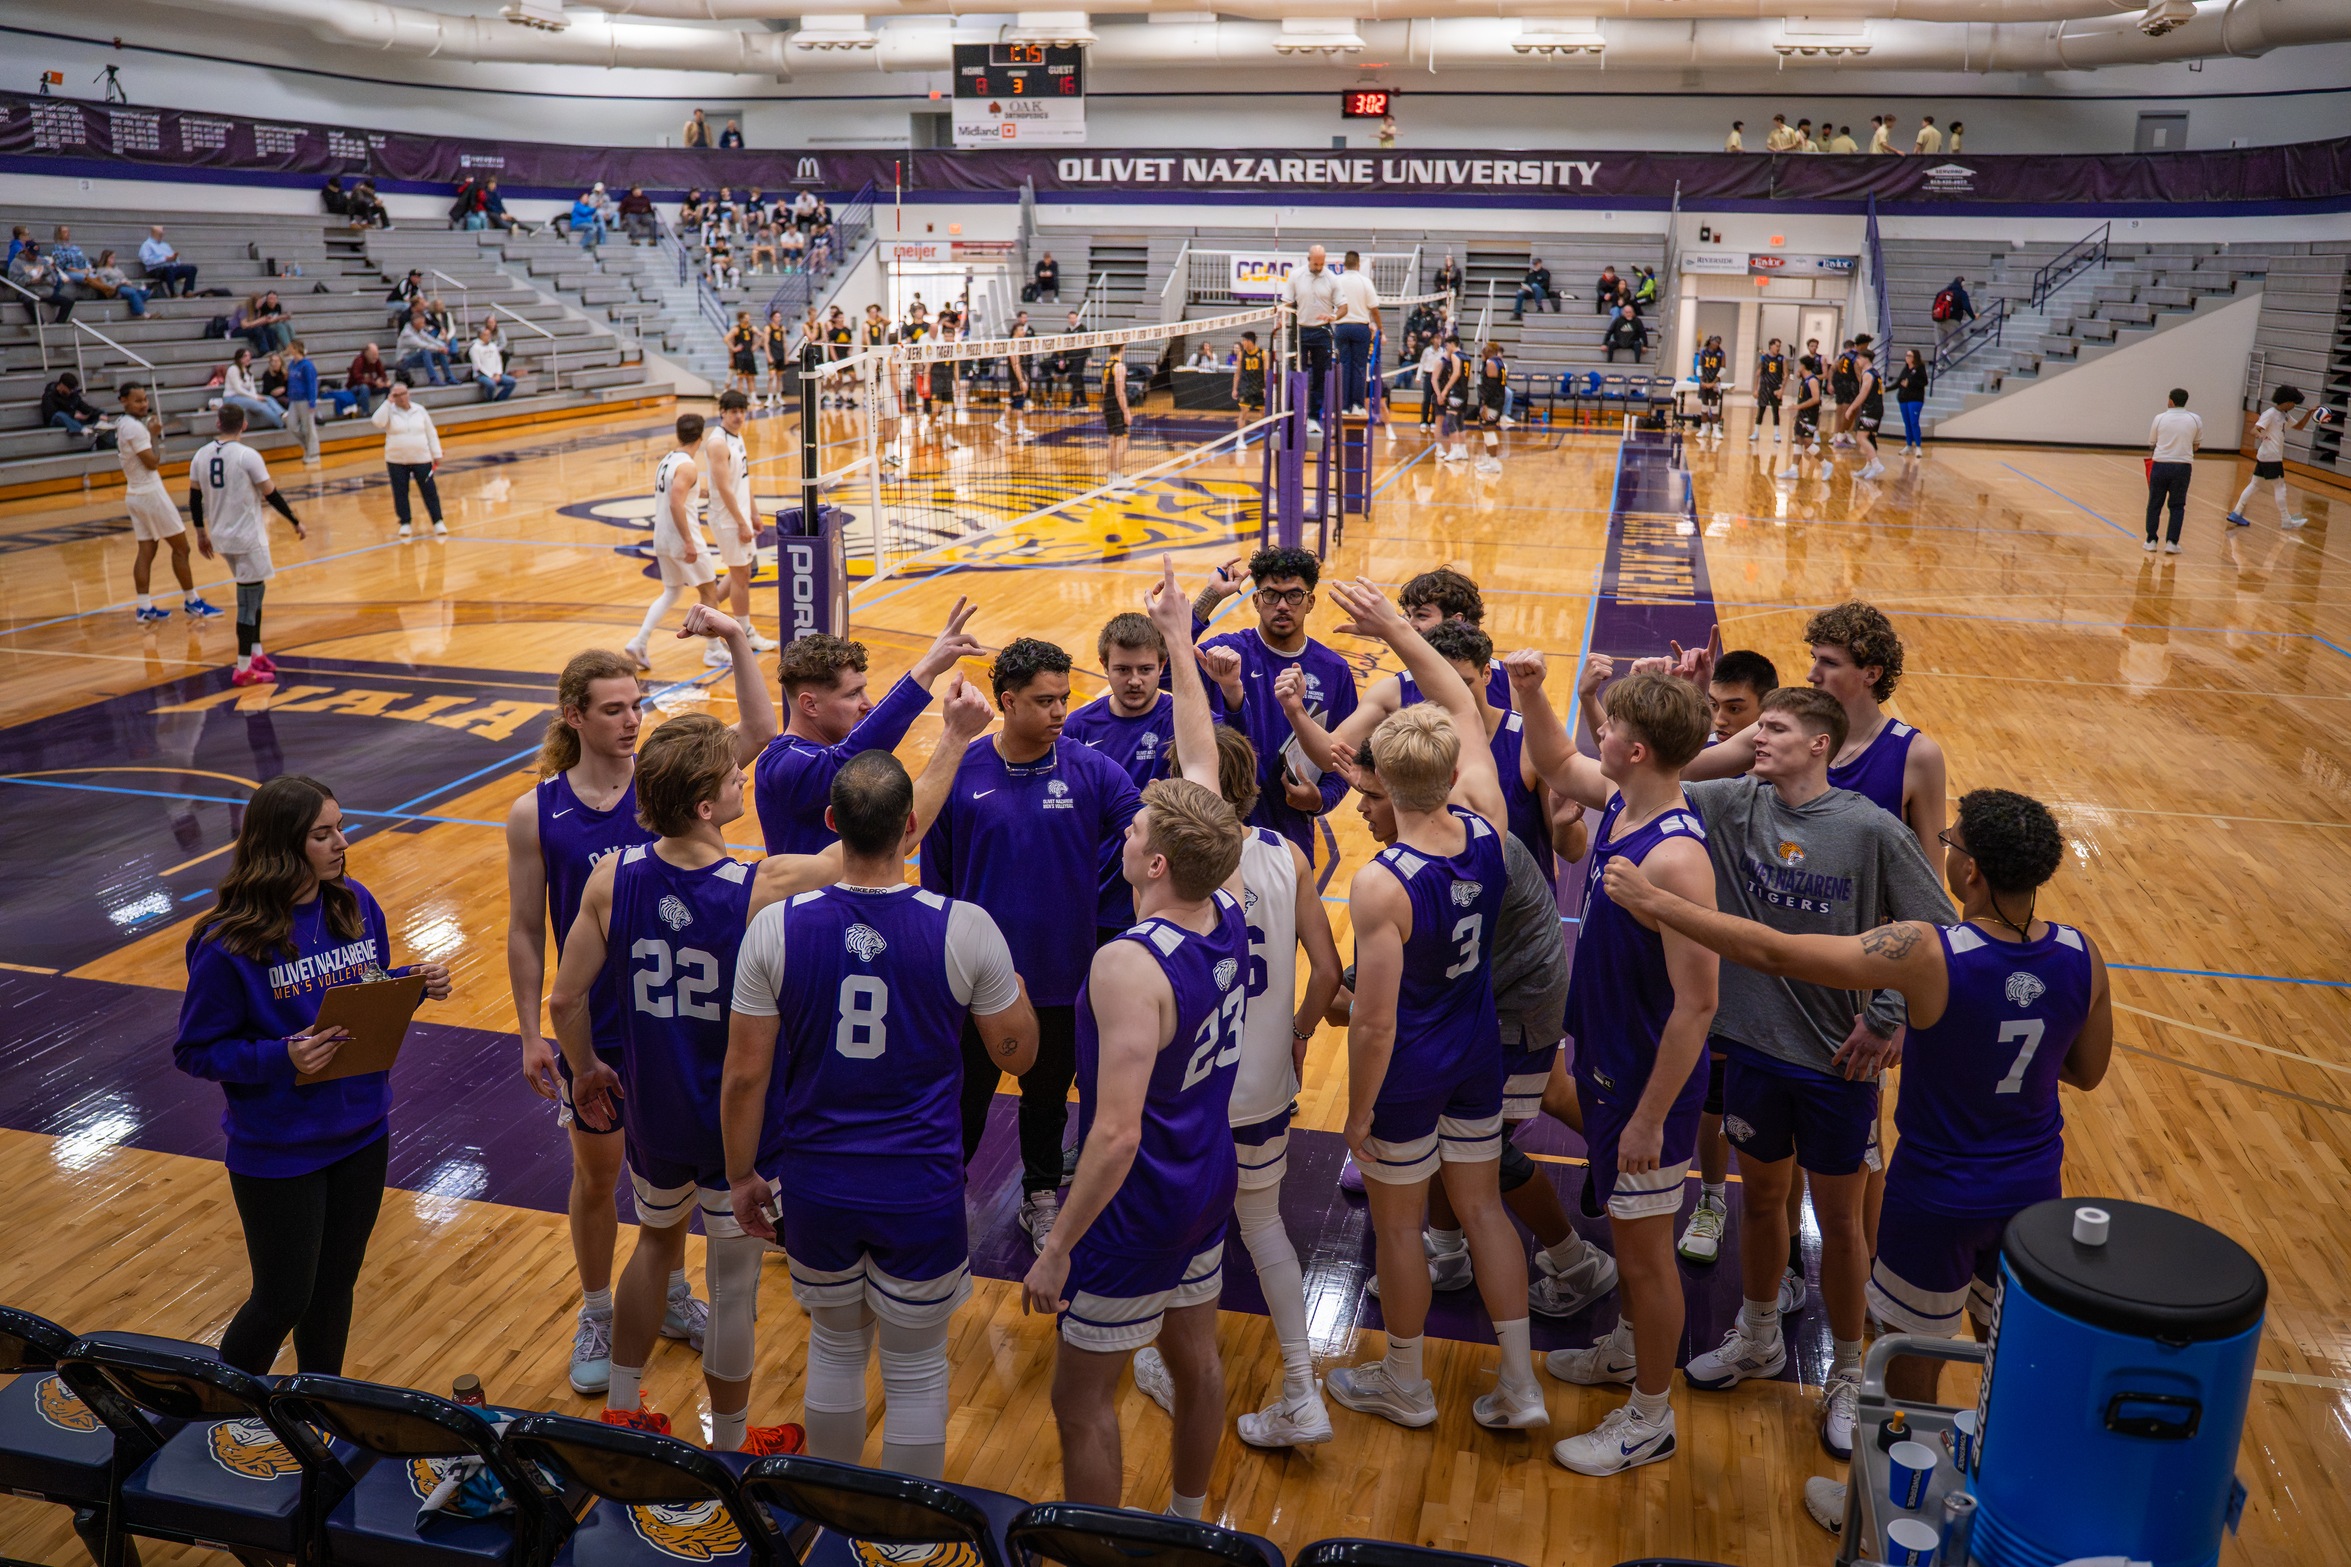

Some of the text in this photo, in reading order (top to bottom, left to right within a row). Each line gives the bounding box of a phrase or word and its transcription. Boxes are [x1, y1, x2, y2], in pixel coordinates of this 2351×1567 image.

[962, 66, 985, 76] HOME
[1048, 65, 1075, 75] GUEST
[1013, 78, 1023, 94] 3
[1009, 101, 1043, 112] OAK
[958, 126, 999, 136] Midland
[1058, 158, 1601, 185] OLIVET NAZARENE UNIVERSITY
[894, 243, 936, 261] meijer
[1754, 257, 1781, 268] Taylor
[1822, 258, 1848, 270] Taylor
[1768, 361, 1776, 373] 6
[210, 457, 224, 488] 8
[147, 683, 558, 742] NAIA
[1747, 880, 1830, 914] TIGERS
[1776, 866, 1853, 902] NAZARENE
[1446, 912, 1482, 980] 3
[268, 939, 377, 988] OLIVET NAZARENE
[274, 960, 376, 1000] MEN'S VOLLEYBA
[632, 938, 721, 1021] 22
[836, 974, 887, 1060] 8
[1180, 984, 1245, 1092] 23
[1996, 1018, 2046, 1094] 7
